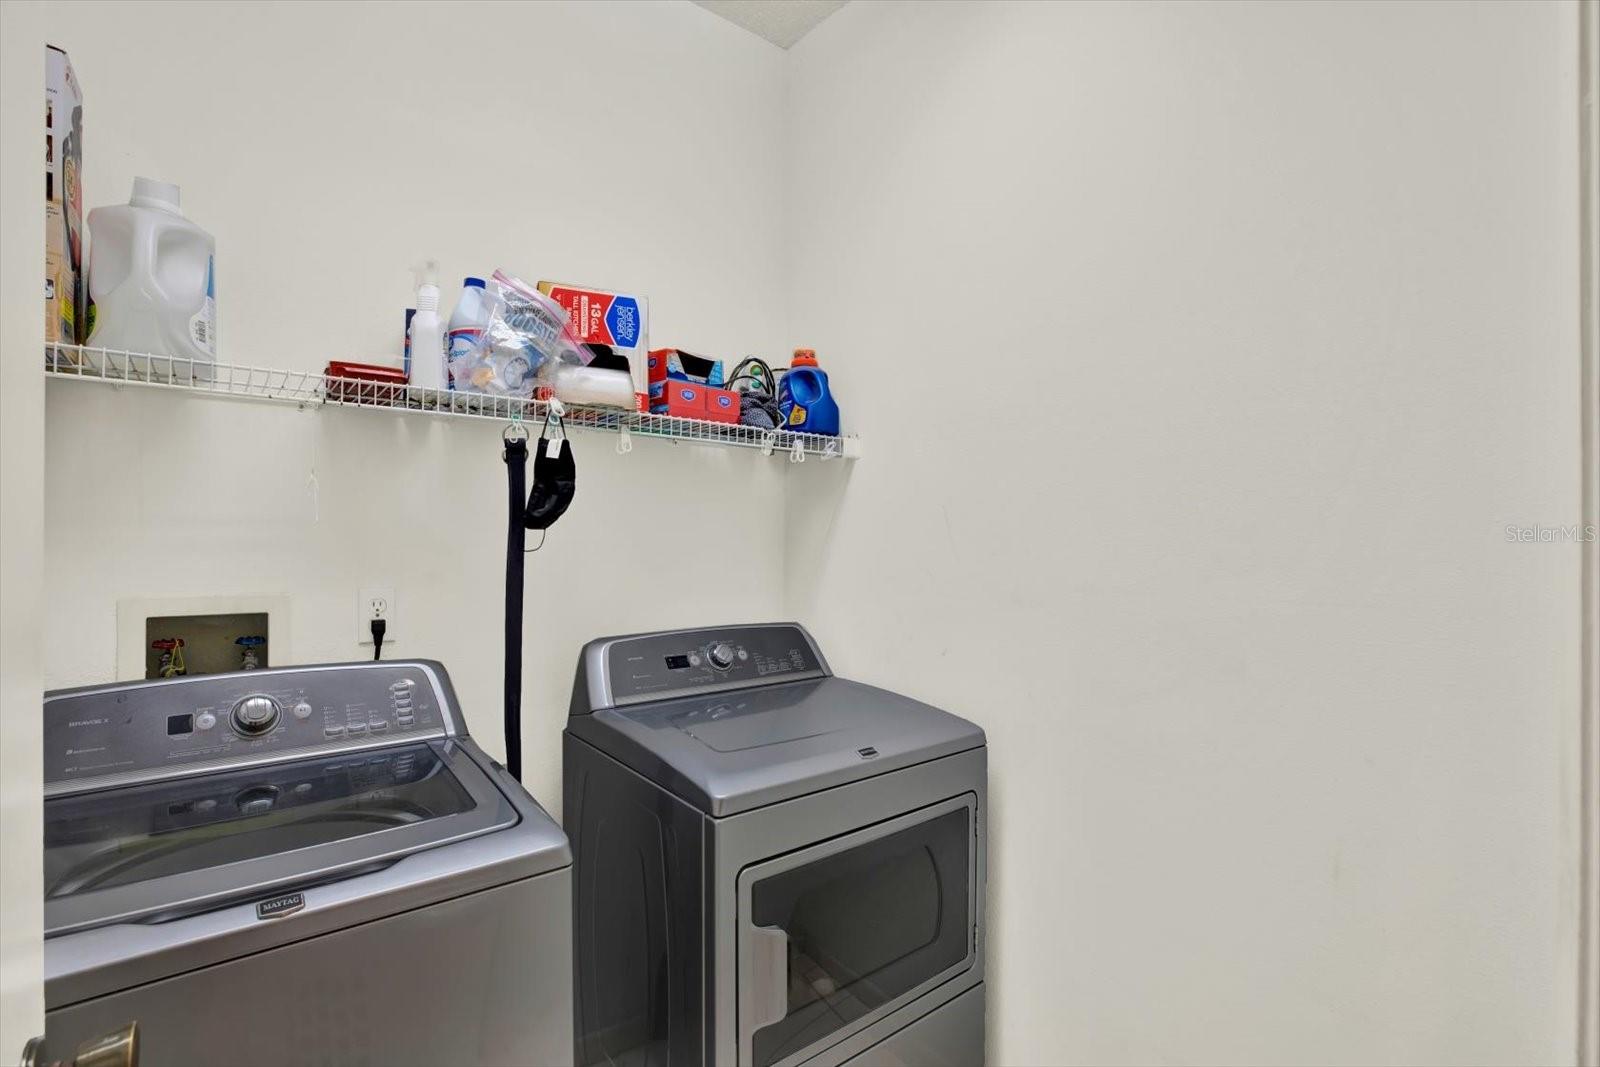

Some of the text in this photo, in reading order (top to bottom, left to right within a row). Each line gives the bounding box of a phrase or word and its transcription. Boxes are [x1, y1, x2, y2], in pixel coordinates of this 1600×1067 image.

[591, 303, 601, 334] 13 GAL
[615, 304, 625, 338] jensen
[624, 307, 636, 342] berkley
[263, 896, 299, 912] MAYTAG
